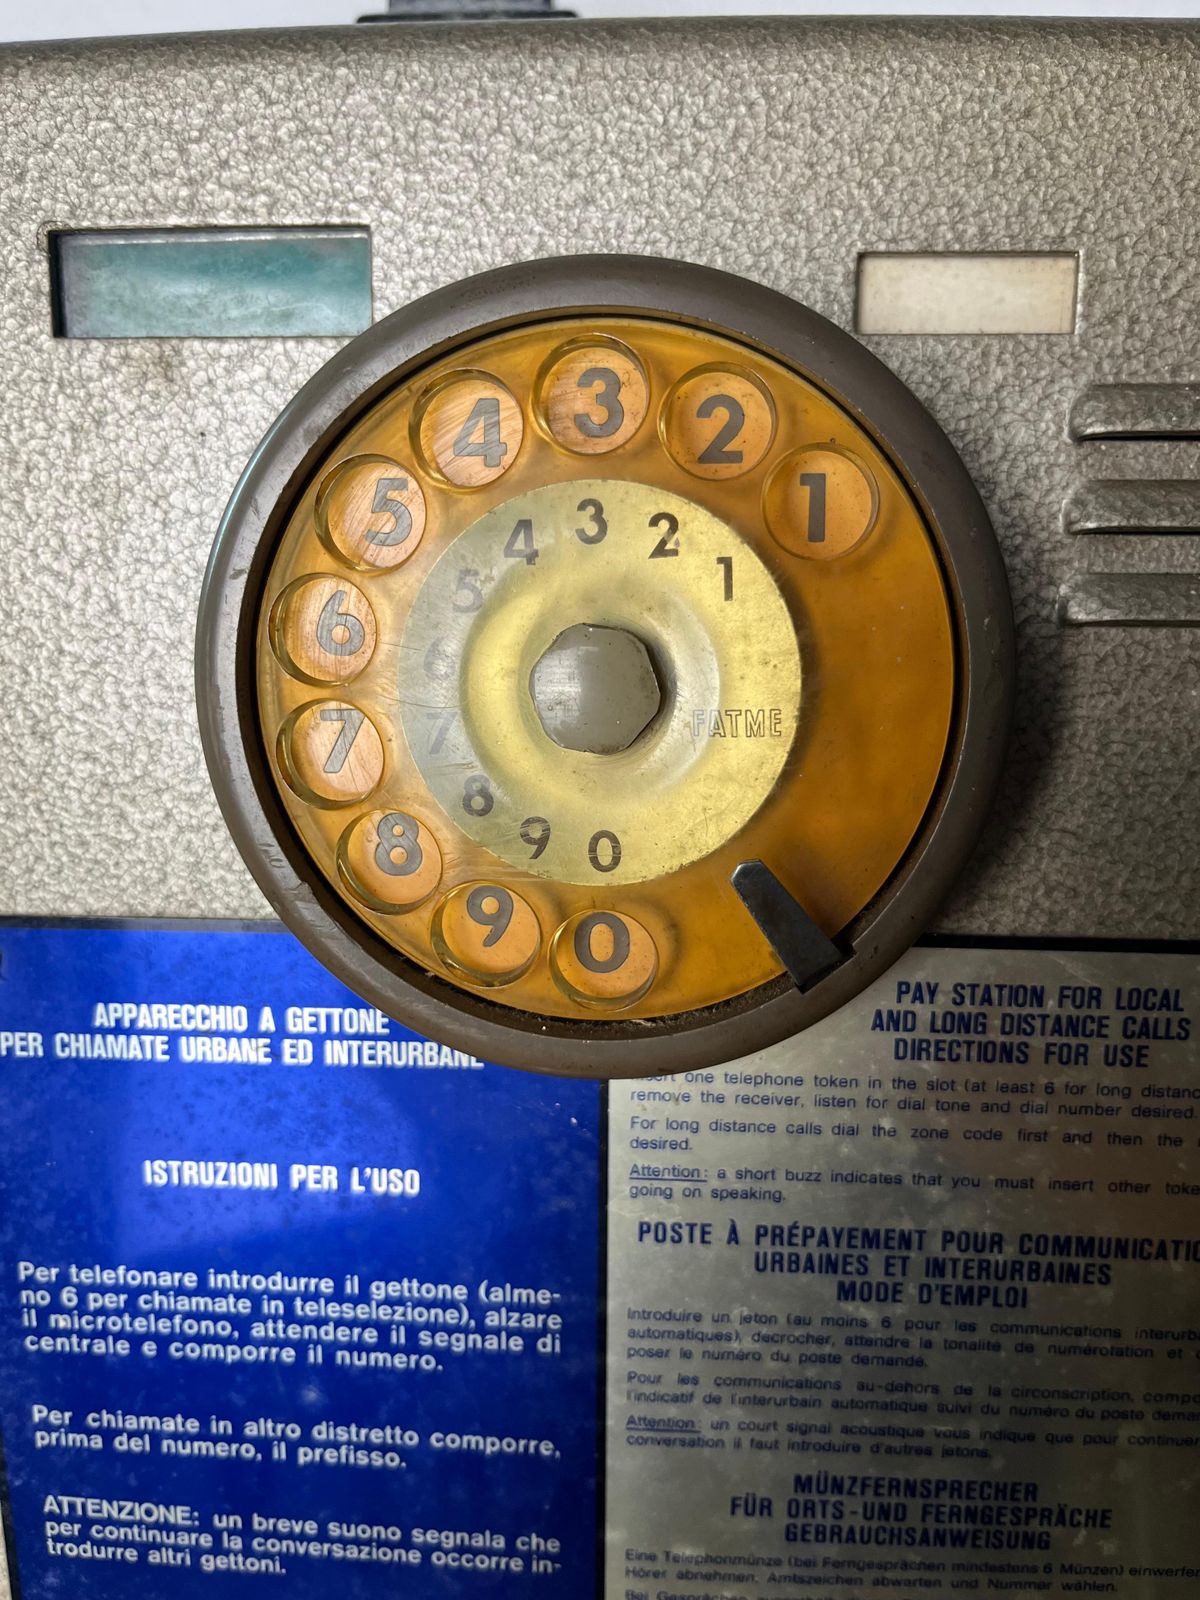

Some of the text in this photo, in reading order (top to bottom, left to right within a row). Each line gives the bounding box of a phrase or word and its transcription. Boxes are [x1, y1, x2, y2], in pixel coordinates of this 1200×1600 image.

[574, 367, 625, 437] 3
[453, 398, 507, 466] 4
[695, 395, 746, 464] 2
[365, 478, 413, 546] 5
[576, 499, 607, 544] 3
[798, 472, 826, 542] 1
[503, 519, 538, 565] 4
[649, 513, 680, 557] 2
[717, 556, 732, 601] 1
[315, 590, 363, 657] 6
[320, 708, 363, 773] 7
[692, 708, 782, 738] FATME
[462, 775, 494, 815] 8
[376, 813, 422, 876] 8
[520, 817, 551, 859] 9
[588, 830, 621, 872] 0
[466, 885, 512, 947] 9
[574, 911, 631, 973] 0
[897, 980, 1184, 1013] PAY STATION FOR LOCAL
[94, 1003, 389, 1033] APPARECCHIO A GETTONE
[871, 1009, 1191, 1042] AND LONG DISTANCE CALLS
[0, 1031, 43, 1057] PER
[55, 1033, 170, 1061] CHIAMATE
[181, 1037, 272, 1064] URBANE
[283, 1039, 313, 1065] ED
[894, 1038, 1149, 1068] DIRECTIONS FOR USE
[631, 1090, 1197, 1120] remove the receiver, listen for dial tone and dial number desired.
[630, 1137, 692, 1151] desired.
[631, 1116, 1183, 1147] For long distance calls dial the zone code first and then the
[143, 1160, 420, 1196] ISTRUZIONI PER L'USO
[630, 1186, 786, 1204] going on speaking.
[717, 1168, 726, 1179] a
[736, 1168, 776, 1181] short
[785, 1169, 822, 1183] buzz
[831, 1170, 903, 1186] indicates
[912, 1173, 942, 1187] that
[951, 1176, 981, 1190] you
[994, 1177, 1035, 1190] must
[1048, 1179, 1094, 1192] insert
[1108, 1180, 1151, 1194] other
[638, 1221, 712, 1245] POSTE
[726, 1219, 740, 1246] À
[755, 1222, 927, 1250] PRÉPAYEMENT
[942, 1230, 1004, 1253] POUR
[18, 1260, 561, 1305] Per telefonare introdurre il gettone (alme-
[754, 1252, 1111, 1285] URBAINES ET INTERURBAINES
[20, 1287, 562, 1330] no 6 per chiamate in teleselezione), alzare
[837, 1281, 1027, 1308] MODE D'EMPLOI
[22, 1308, 561, 1354] il microtelefono, attendere il segnale di
[24, 1335, 443, 1371] centrale e comporre il numero.
[32, 1404, 561, 1458] Per chiamate in altro distretto comporre,
[35, 1429, 406, 1468] prima del numero, il prefisso.
[794, 1471, 1038, 1501] MÜNZFERNSPRECHER
[44, 1495, 560, 1553] ATTENZIONE: un breve suono segnala che
[730, 1492, 772, 1518] FÜR
[922, 1504, 1113, 1529] FERNGESPRÄCHE
[45, 1521, 561, 1574] per continuare la conversazione occorre in-
[47, 1538, 286, 1574] trodurre altri gettoni.
[784, 1523, 1050, 1550] GEBRAUCHSANWEISUNG
